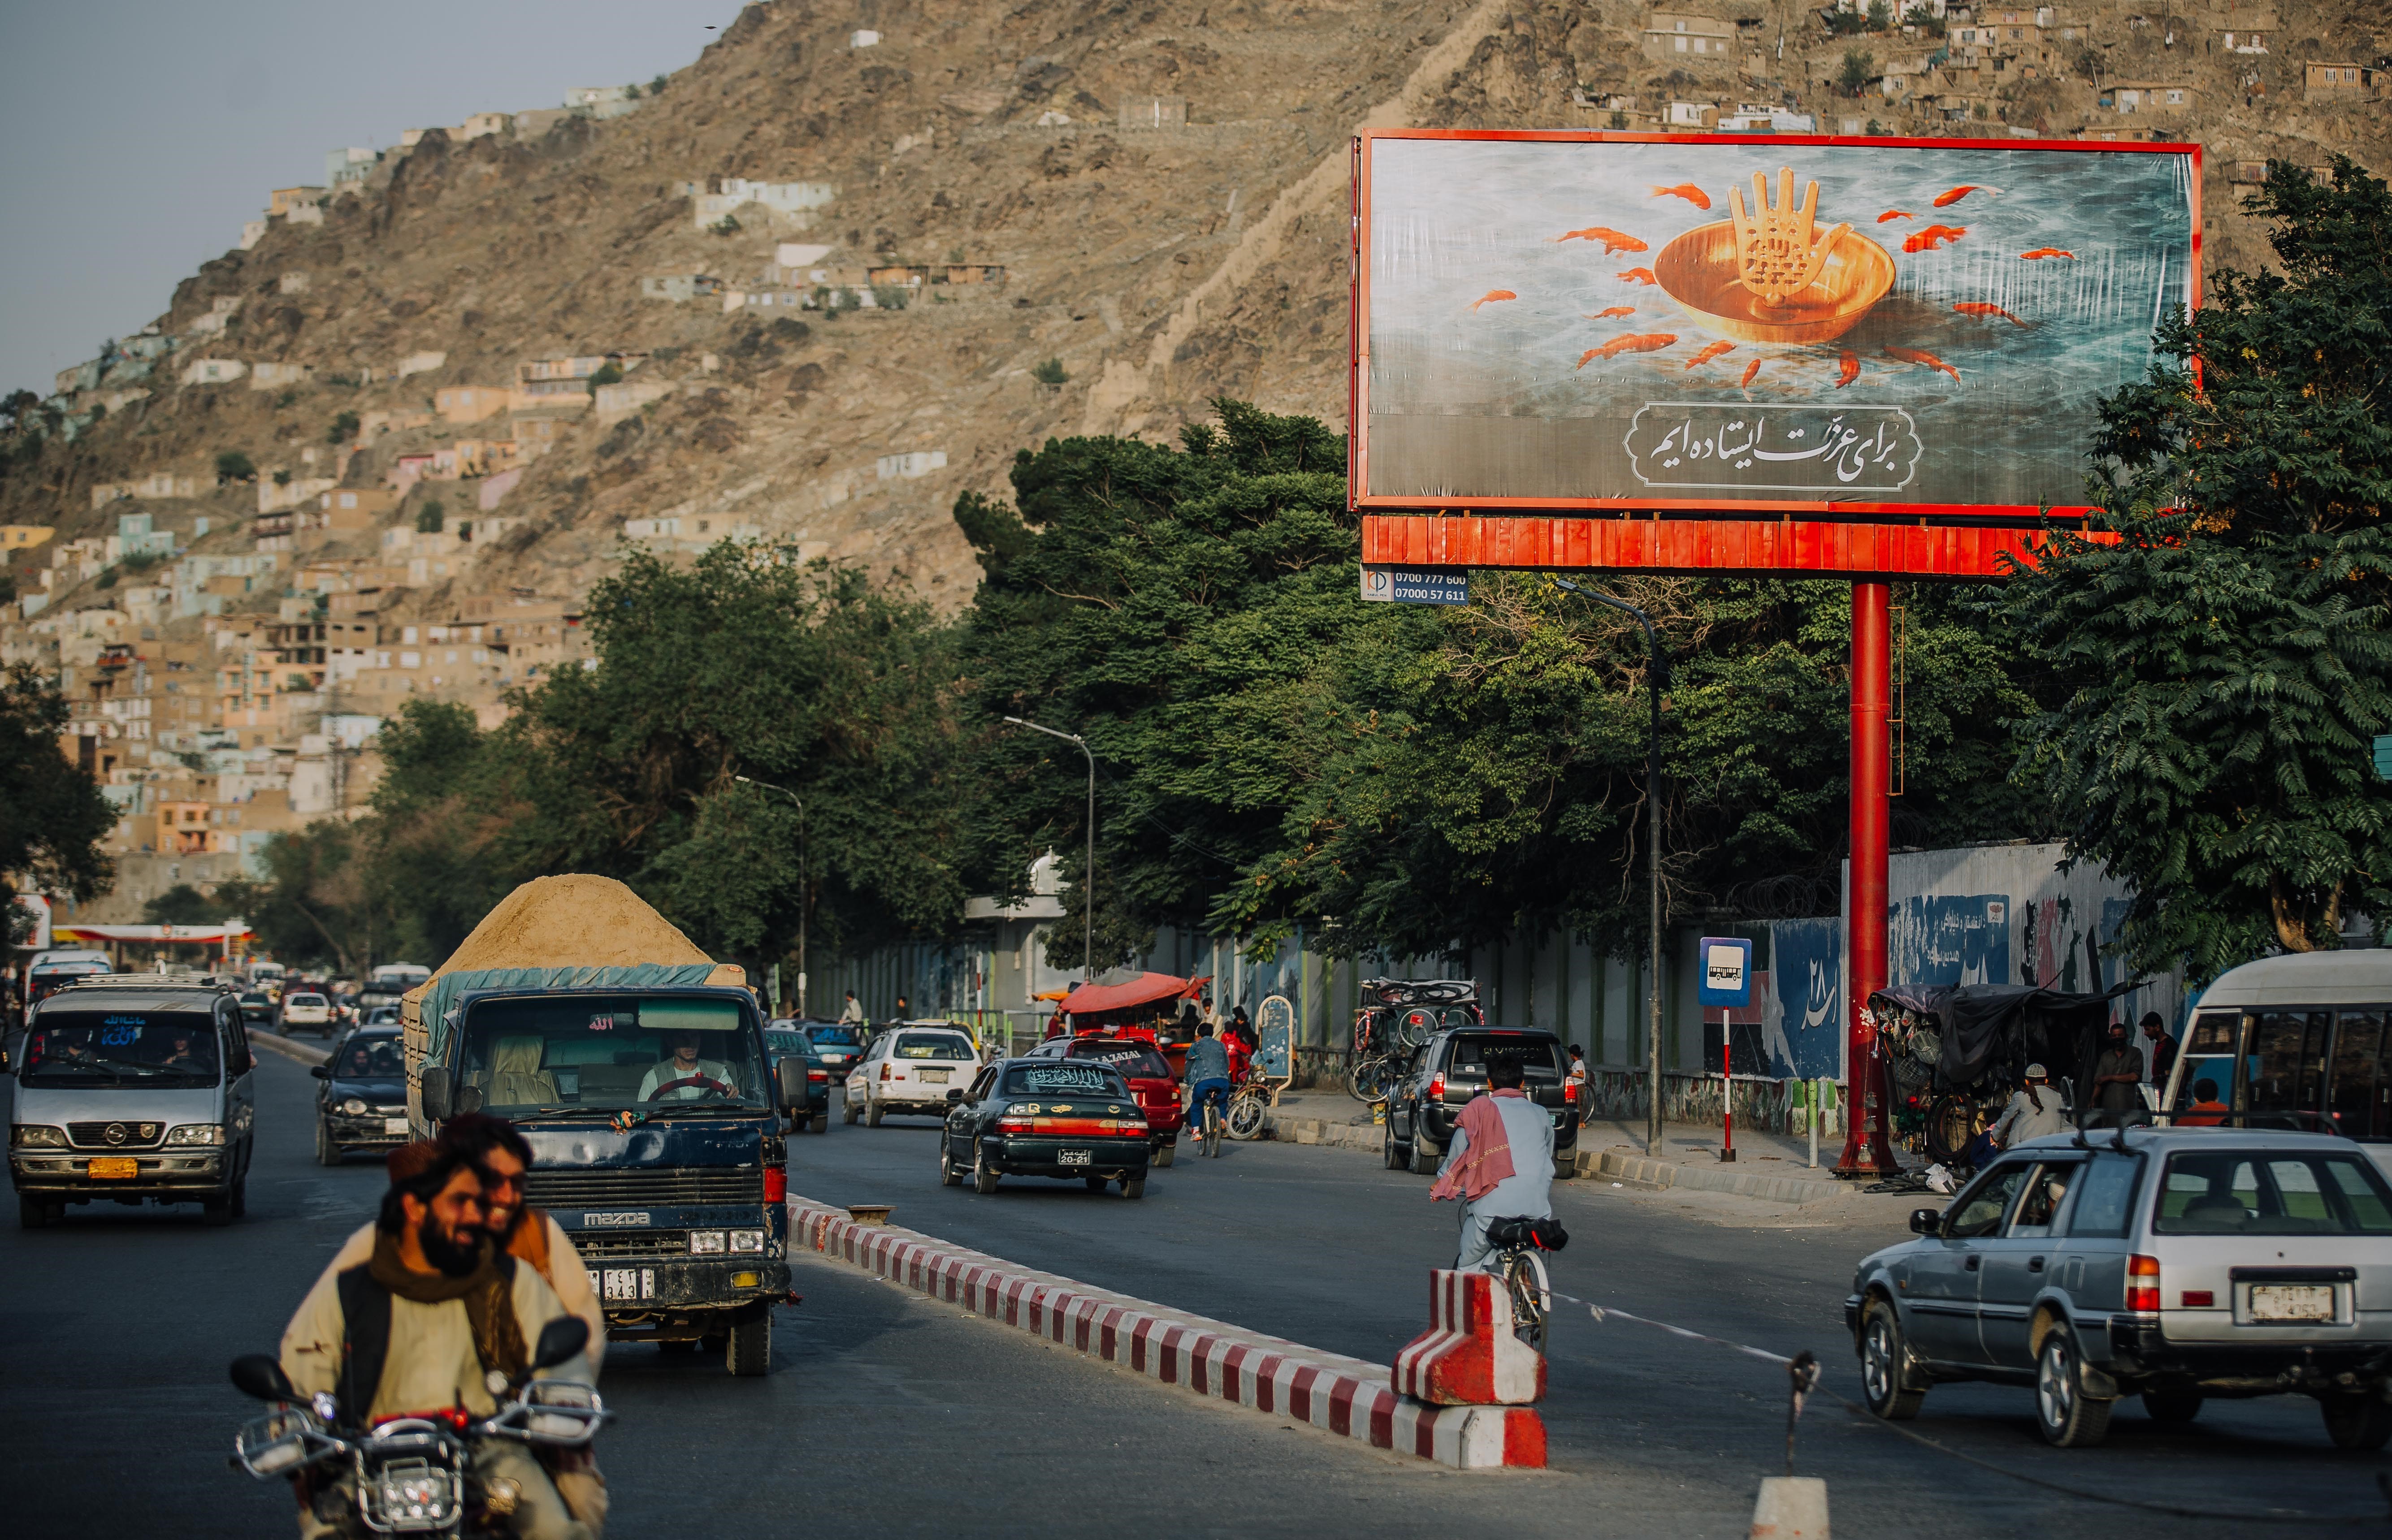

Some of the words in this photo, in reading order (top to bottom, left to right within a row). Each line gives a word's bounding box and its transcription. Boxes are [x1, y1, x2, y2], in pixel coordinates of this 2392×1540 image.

[1838, 422, 1897, 482] برای
[1395, 572, 1421, 583] 0700
[1425, 575, 1443, 584] 777
[1446, 575, 1466, 585] 600
[1395, 588, 1428, 599] 07000
[1430, 590, 1443, 600] 57
[1446, 591, 1465, 601] 611
[1801, 967, 1837, 1030] اسد
[589, 1016, 613, 1030] الله
[607, 1285, 635, 1298] 343
